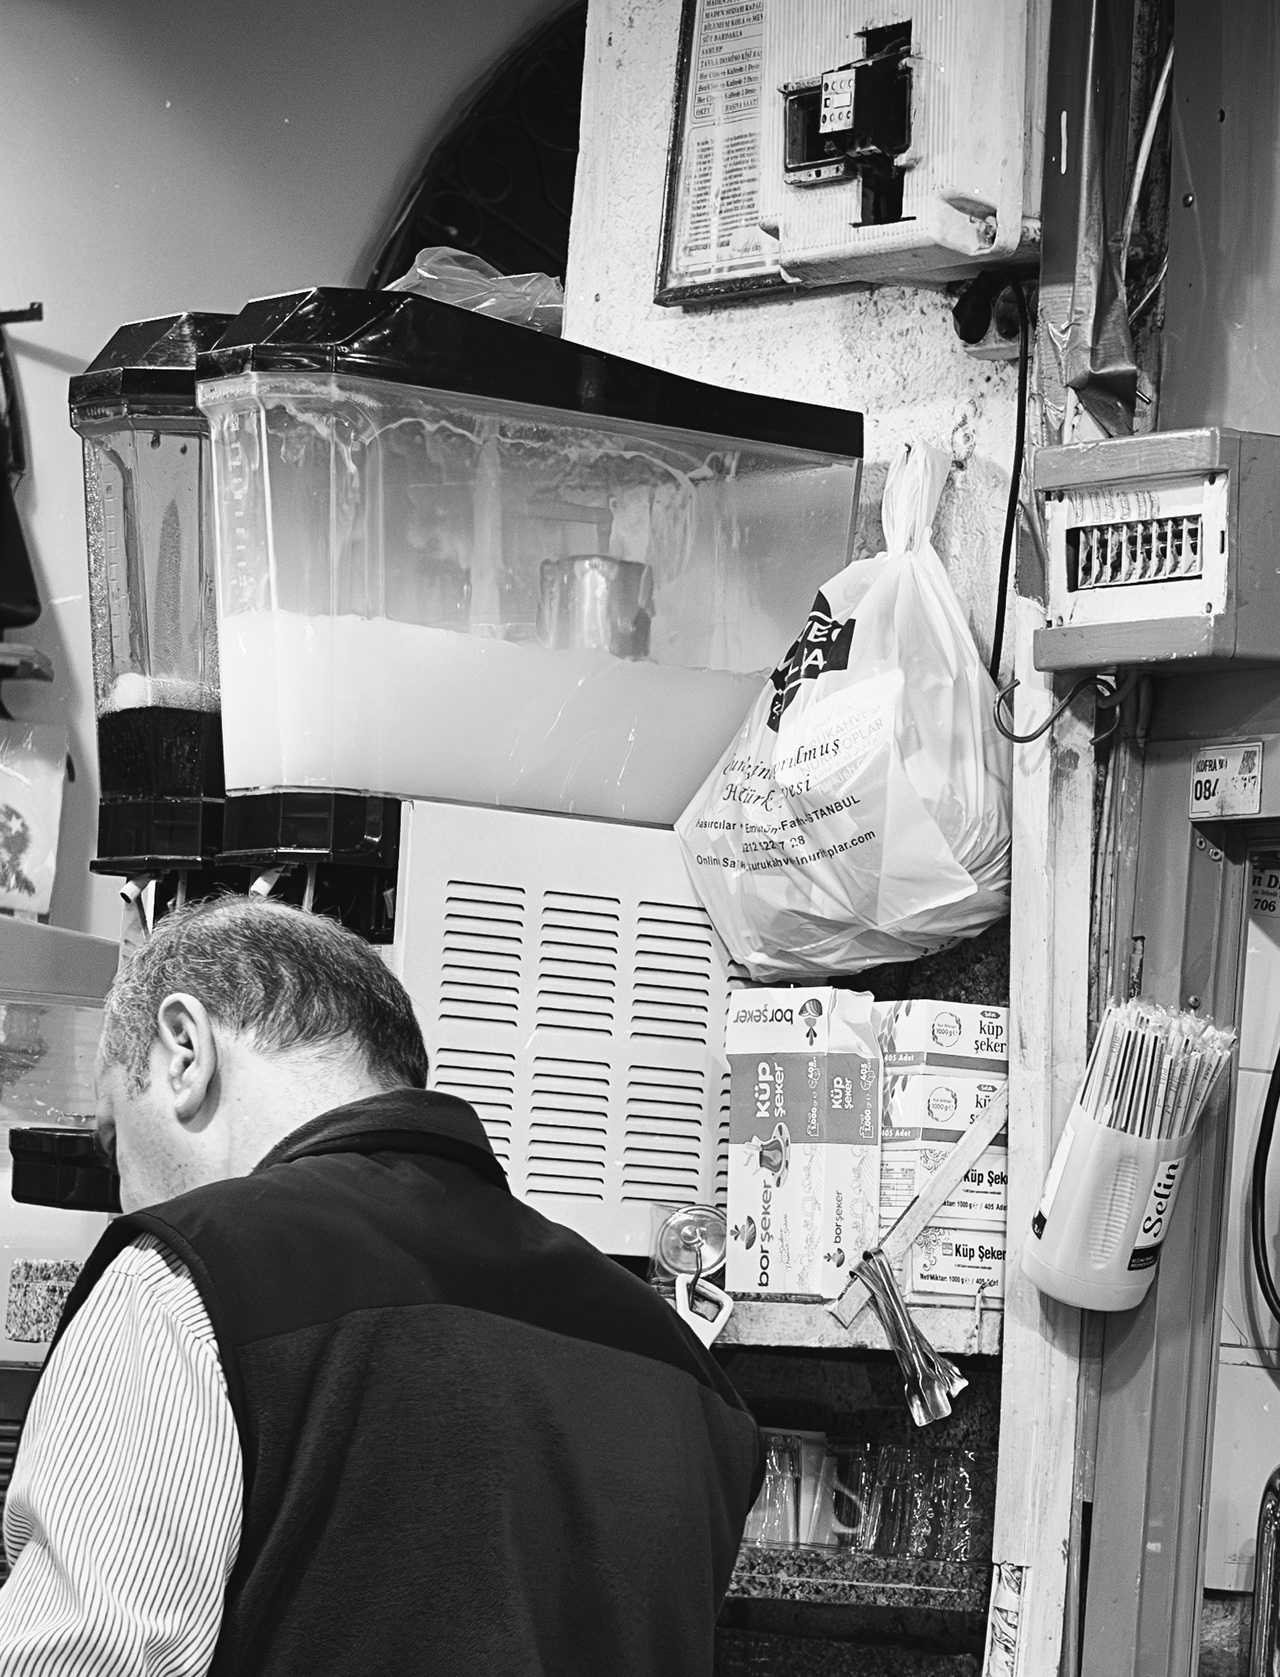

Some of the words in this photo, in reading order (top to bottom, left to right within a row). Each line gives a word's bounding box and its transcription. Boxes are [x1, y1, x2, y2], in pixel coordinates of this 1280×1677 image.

[1252, 898, 1276, 912] 706
[733, 1004, 794, 1025] borşeker
[978, 1020, 1004, 1040] küp
[973, 1038, 1008, 1054] şeker
[898, 1053, 916, 1062] Adet
[754, 1061, 775, 1118] Küp
[774, 1062, 787, 1118] şeker
[830, 1076, 845, 1109] Küp
[894, 1129, 912, 1138] Adet
[984, 1203, 995, 1211] 405
[1142, 1161, 1180, 1238] Selin
[833, 1190, 845, 1244] borşeker
[757, 1179, 774, 1288] borşeker
[954, 1244, 976, 1260] Küp
[978, 1245, 1007, 1262] Şeker
